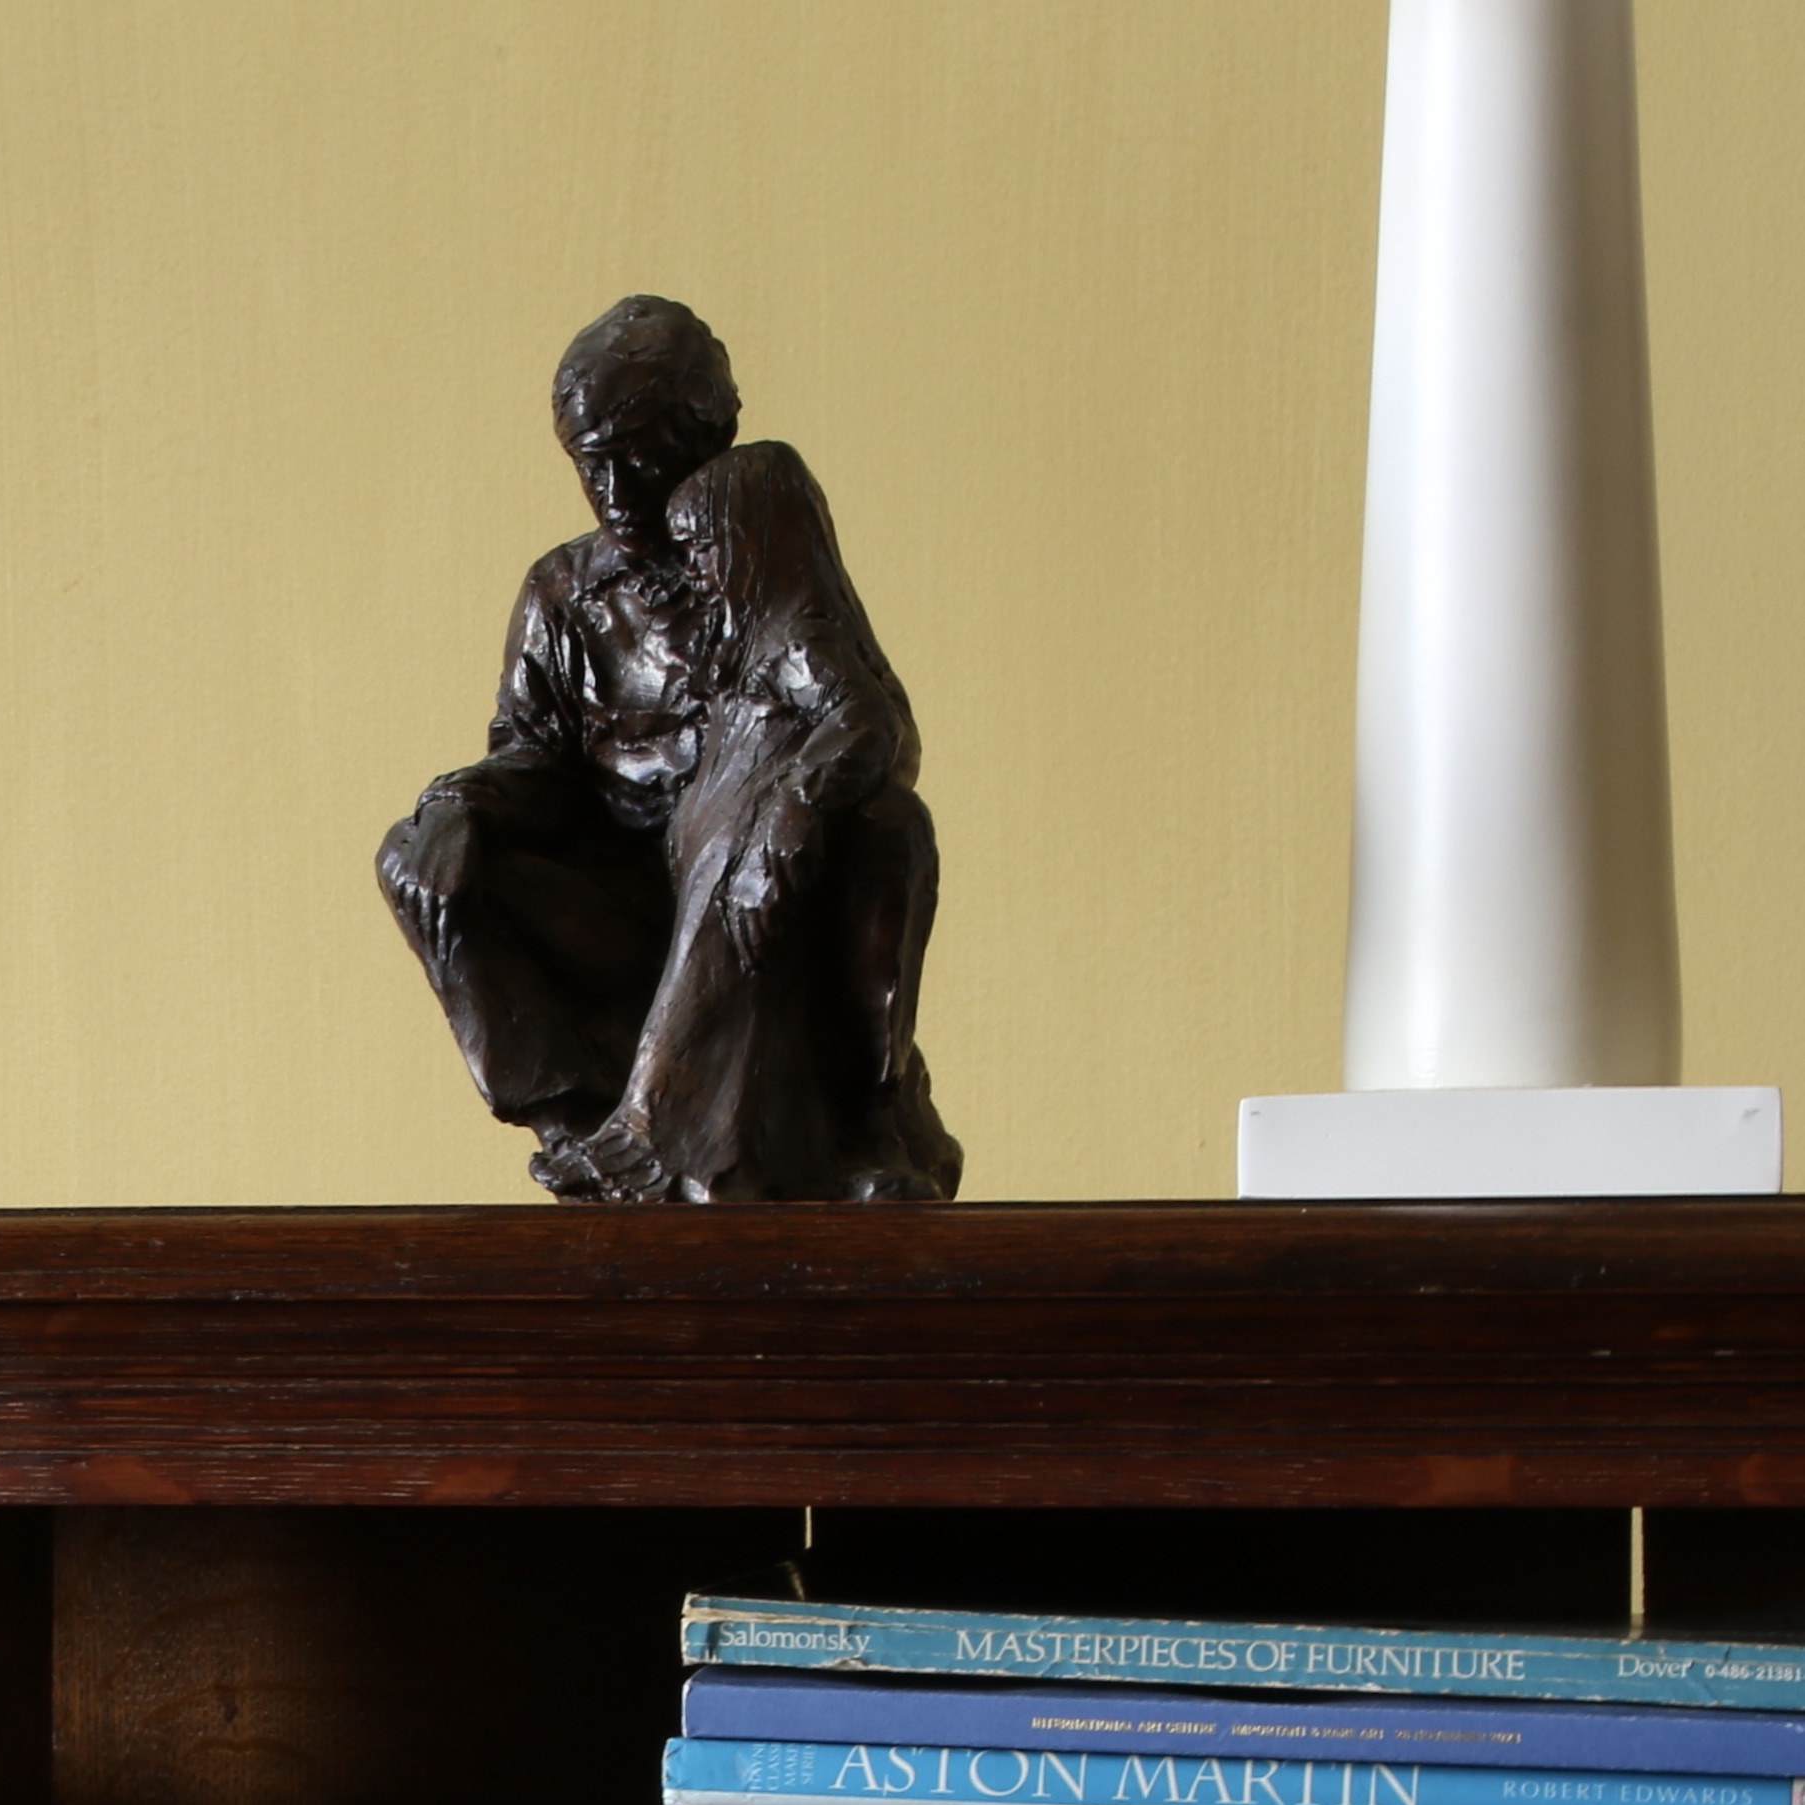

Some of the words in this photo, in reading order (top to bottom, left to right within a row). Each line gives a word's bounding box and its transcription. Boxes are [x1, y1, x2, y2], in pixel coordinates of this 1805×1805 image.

[717, 1622, 871, 1652] Salomonsky
[955, 1630, 1237, 1671] MASTERPIECES
[1244, 1641, 1295, 1673] OF
[1306, 1643, 1527, 1681] FURNITURE
[1617, 1655, 1693, 1679] Dover
[1031, 1716, 1133, 1732] INTERNATIONAL
[1165, 1720, 1216, 1736] CENTRE
[1230, 1723, 1307, 1739] IMPORTANT
[829, 1743, 1088, 1800] ASTON
[1503, 1780, 1606, 1801] ROBERT
